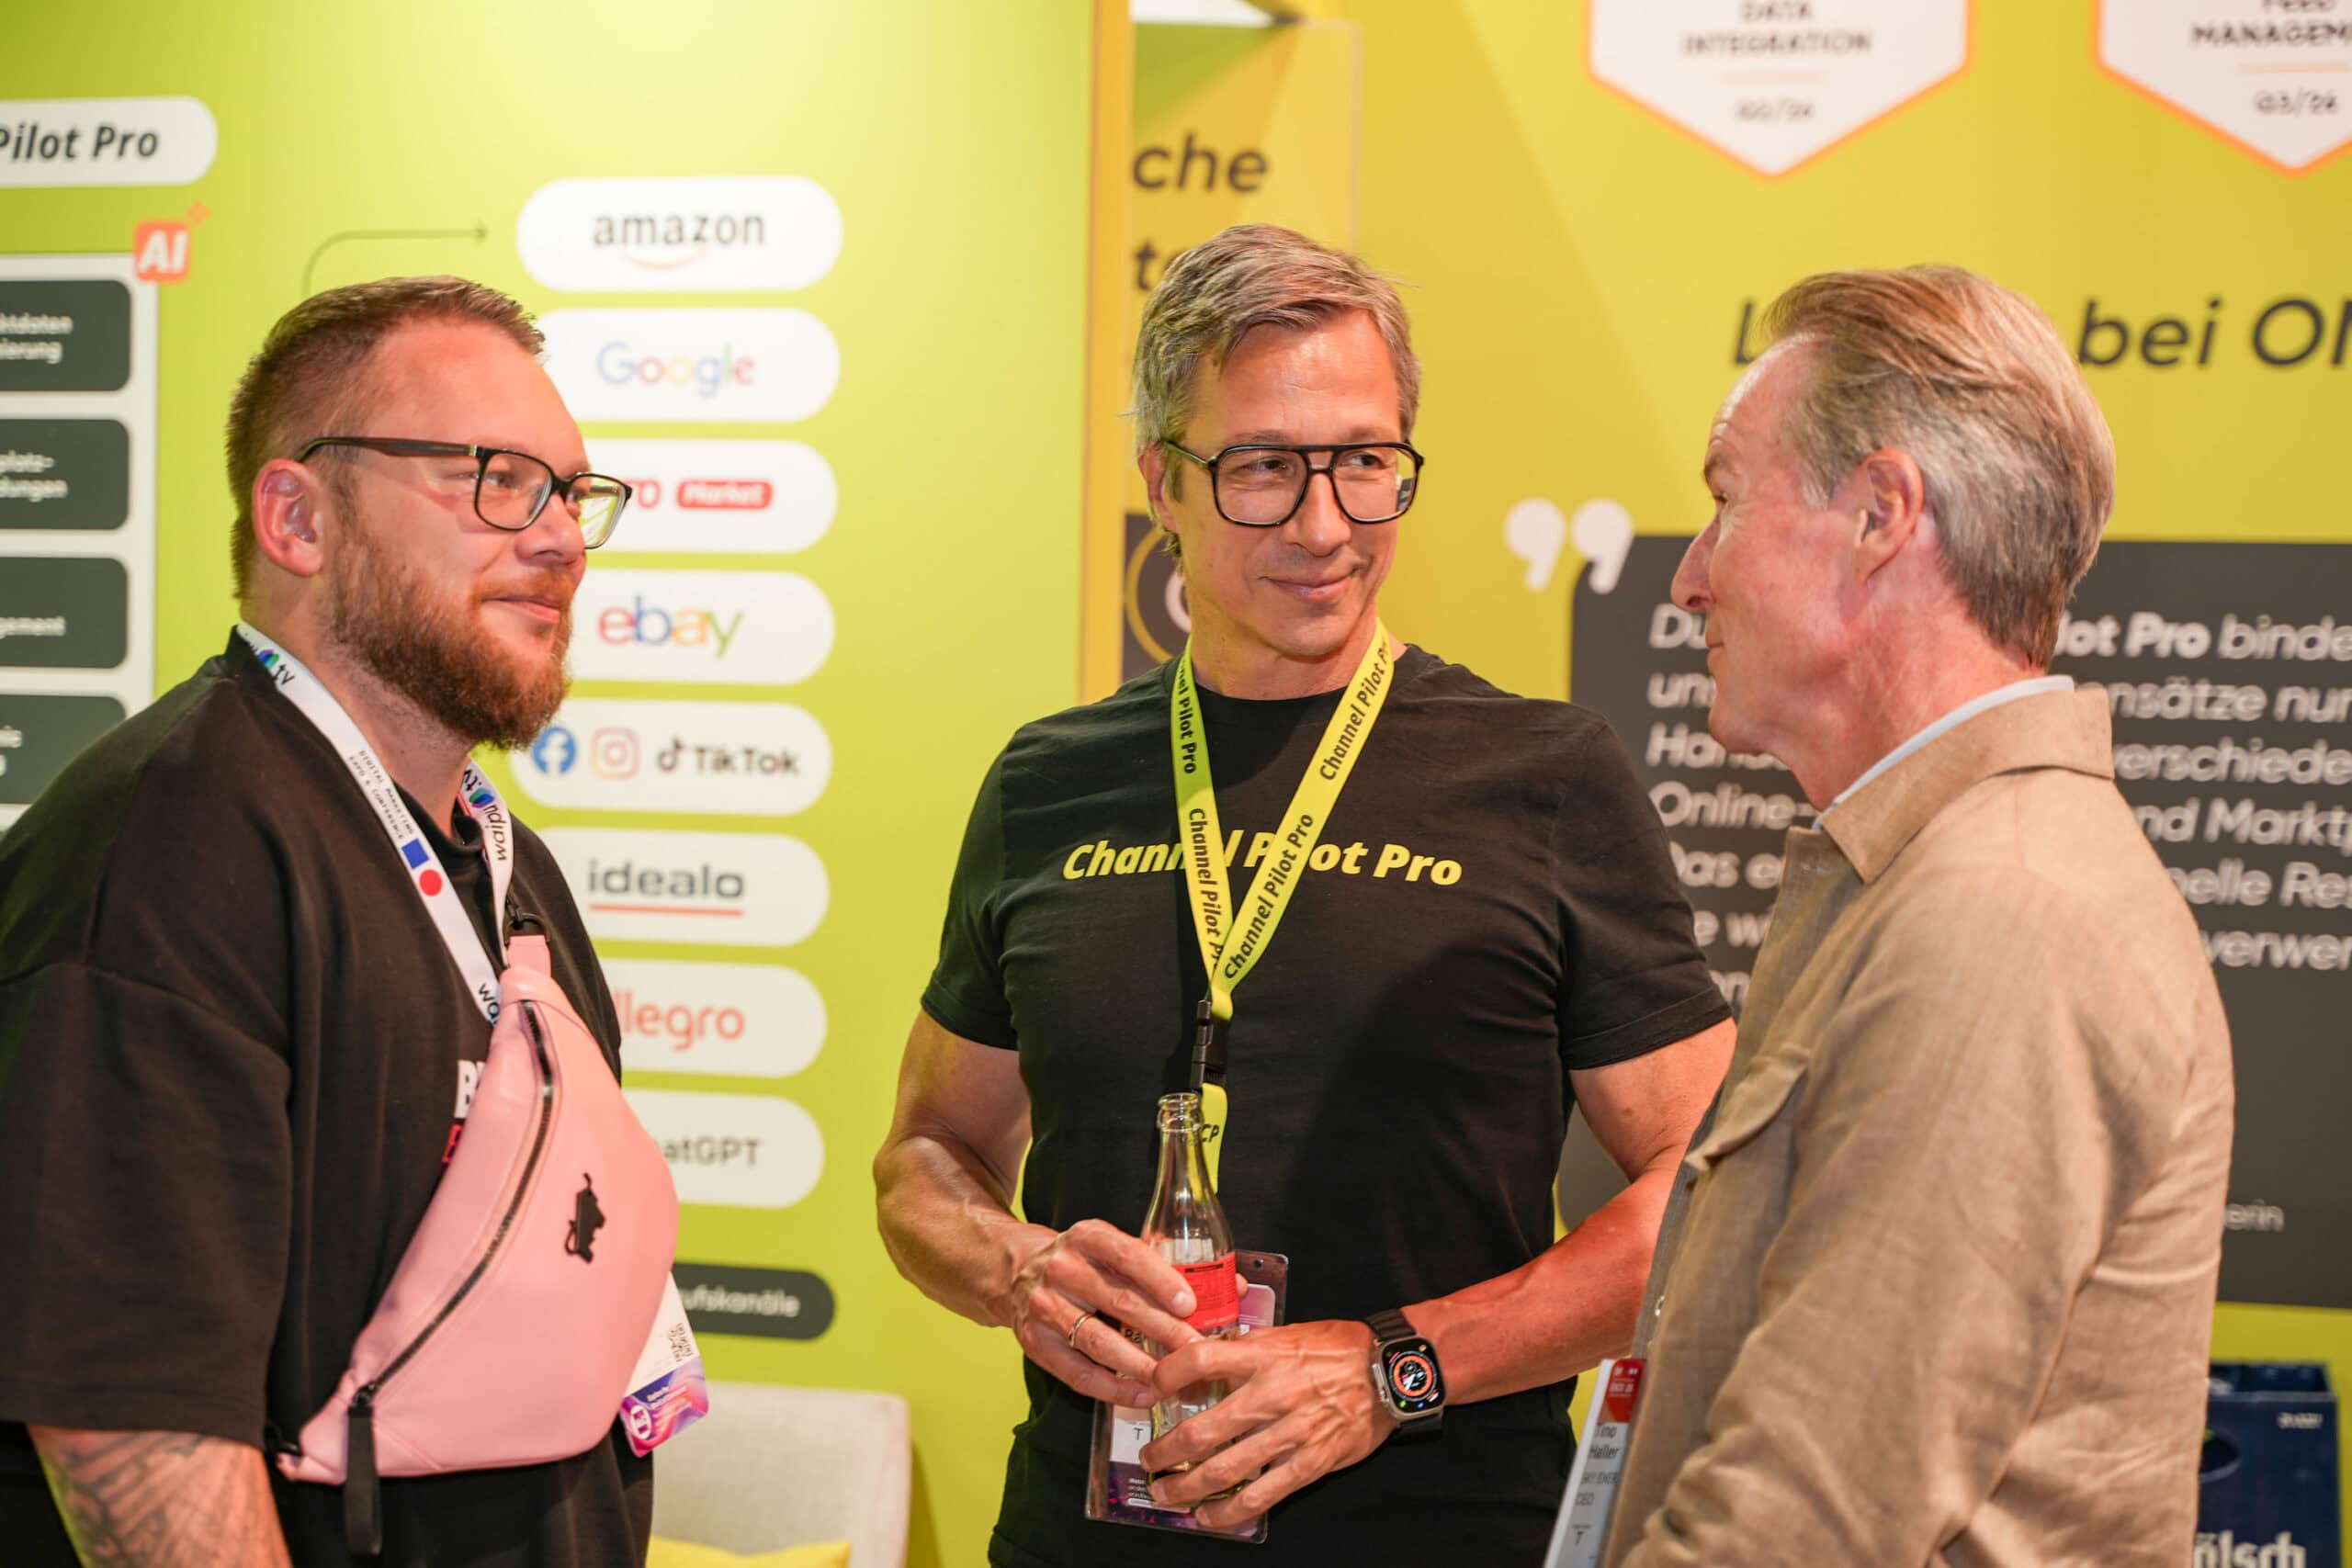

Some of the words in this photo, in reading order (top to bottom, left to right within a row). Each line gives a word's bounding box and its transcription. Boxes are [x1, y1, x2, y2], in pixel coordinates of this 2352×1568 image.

[1684, 32, 1872, 55] INTEGRATION
[92, 125, 160, 159] Pro
[1133, 131, 1270, 194] che
[139, 229, 189, 275] AI
[594, 214, 765, 246] amazon
[2076, 298, 2223, 367] bei
[597, 340, 756, 399] Google
[598, 595, 744, 659] ebay
[2054, 610, 2120, 658] lot
[2124, 610, 2212, 660] Pro
[1178, 696, 1194, 739] Pilot
[1318, 703, 1366, 781] Channel
[1356, 662, 1385, 708] Pilot
[694, 746, 800, 775] TikTok
[1181, 741, 1197, 774] Pro
[482, 802, 507, 862] waipu
[2132, 796, 2201, 842] nd
[1063, 829, 1244, 880] Channl
[1243, 832, 1369, 874] Pot
[1372, 842, 1464, 886] Pro
[1189, 807, 1218, 886] Channel
[588, 860, 746, 899] idealo
[1224, 895, 1275, 980] Channel
[1263, 849, 1298, 898] Pilot
[1286, 814, 1314, 849] Pro
[1200, 889, 1223, 937] Pilot
[614, 990, 745, 1051] llegro
[663, 1135, 764, 1167] atGPT
[1133, 1427, 1144, 1441] T
[2193, 1530, 2307, 1568] ölsch
